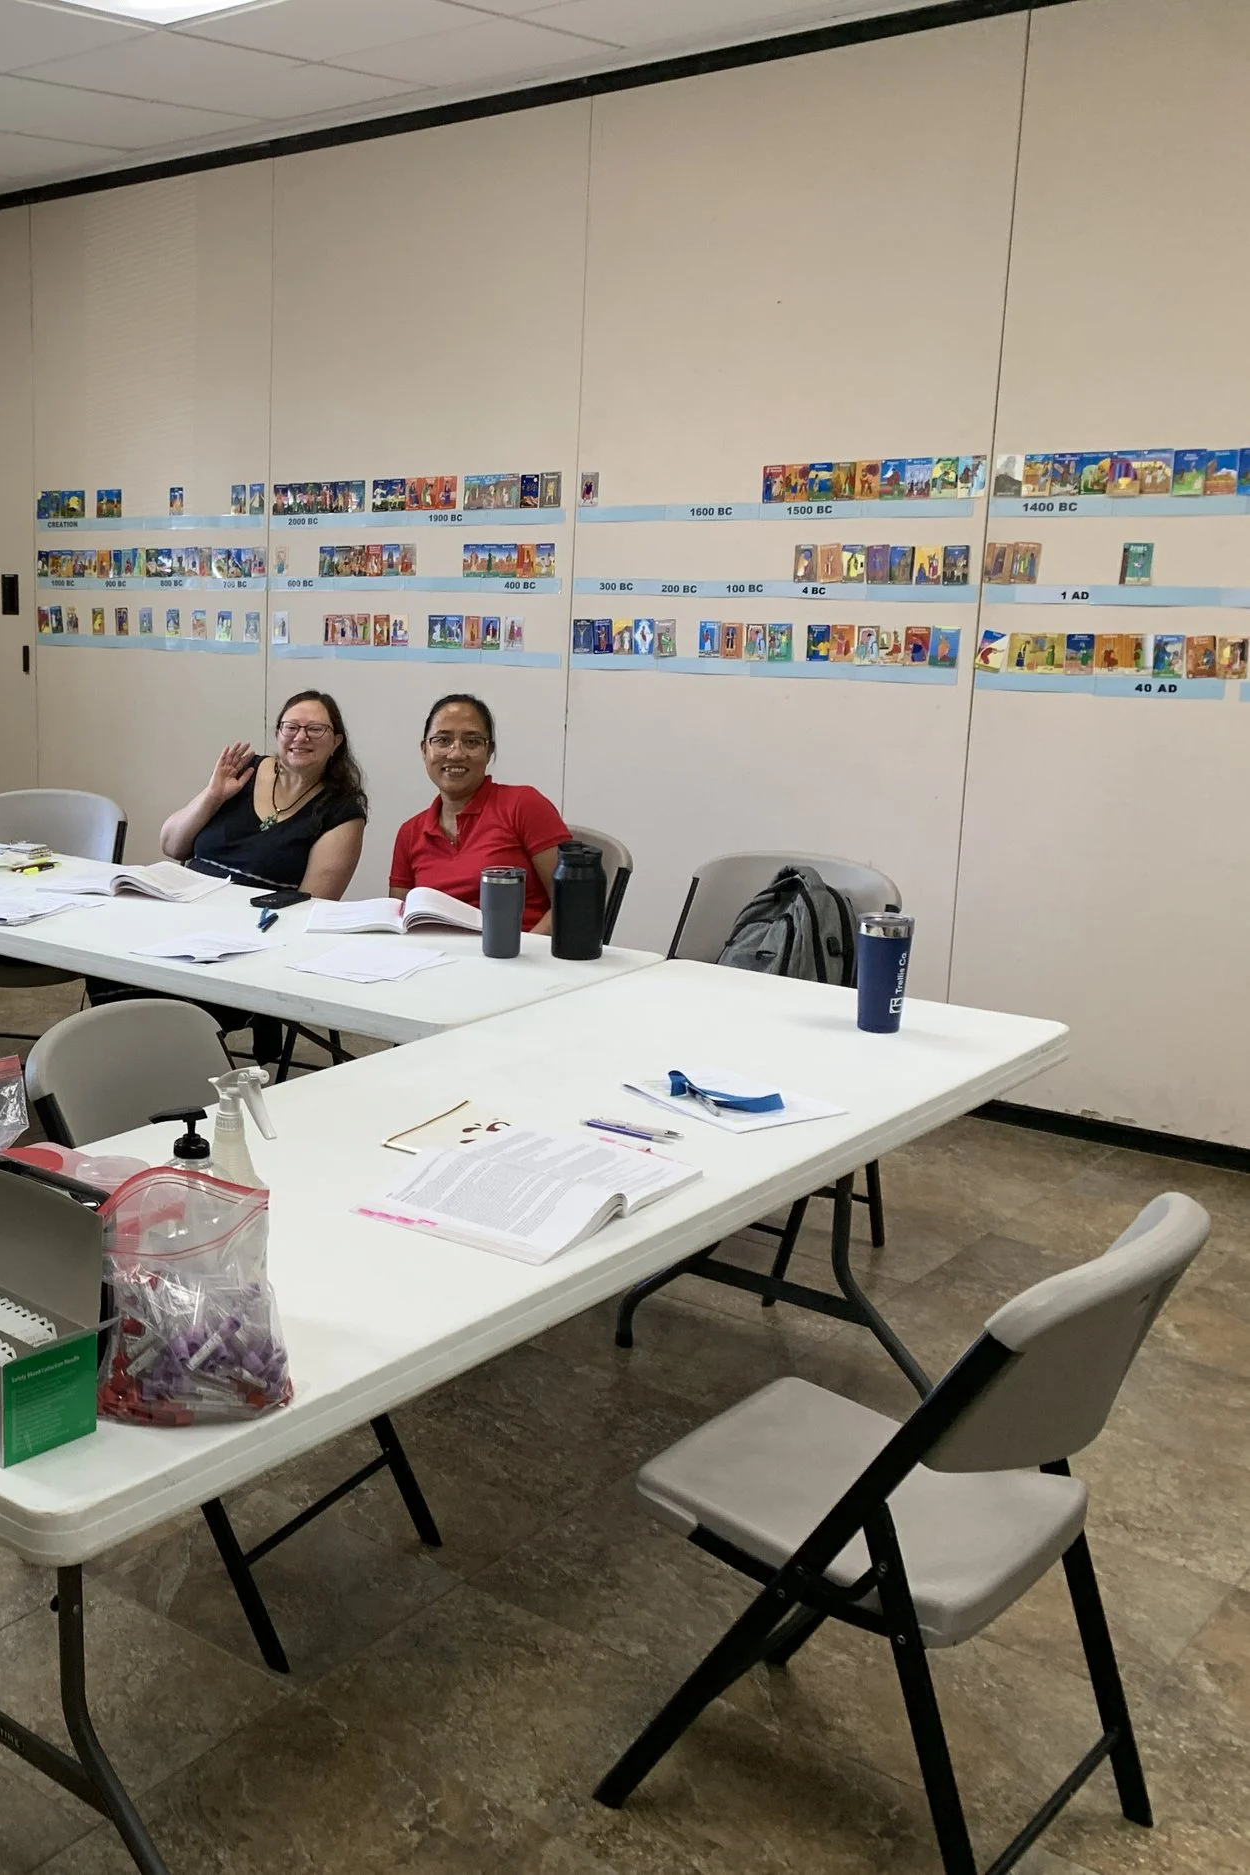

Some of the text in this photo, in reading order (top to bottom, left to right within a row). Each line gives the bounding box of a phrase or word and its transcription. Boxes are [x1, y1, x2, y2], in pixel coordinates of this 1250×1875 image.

[690, 506, 733, 517] 1600 BC
[786, 505, 833, 515] 1500 BC
[1022, 502, 1078, 512] 1400 BC
[287, 517, 319, 526] 2000 BC
[428, 513, 463, 522] 1900 BC
[47, 521, 78, 529] CREATION
[65, 579, 75, 587] BC
[117, 580, 127, 588] BC
[171, 579, 183, 587] BC
[237, 580, 247, 588] BC
[287, 579, 314, 588] 600 BC
[504, 581, 536, 590] 400 BC
[599, 582, 634, 591] 300 BC
[661, 584, 697, 594] 200 BC
[726, 583, 764, 593] 100 BC
[801, 586, 826, 595] 4 BC
[1060, 591, 1090, 600] 1 AD
[1134, 683, 1178, 694] 40 AD
[895, 967, 907, 995] Trellis
